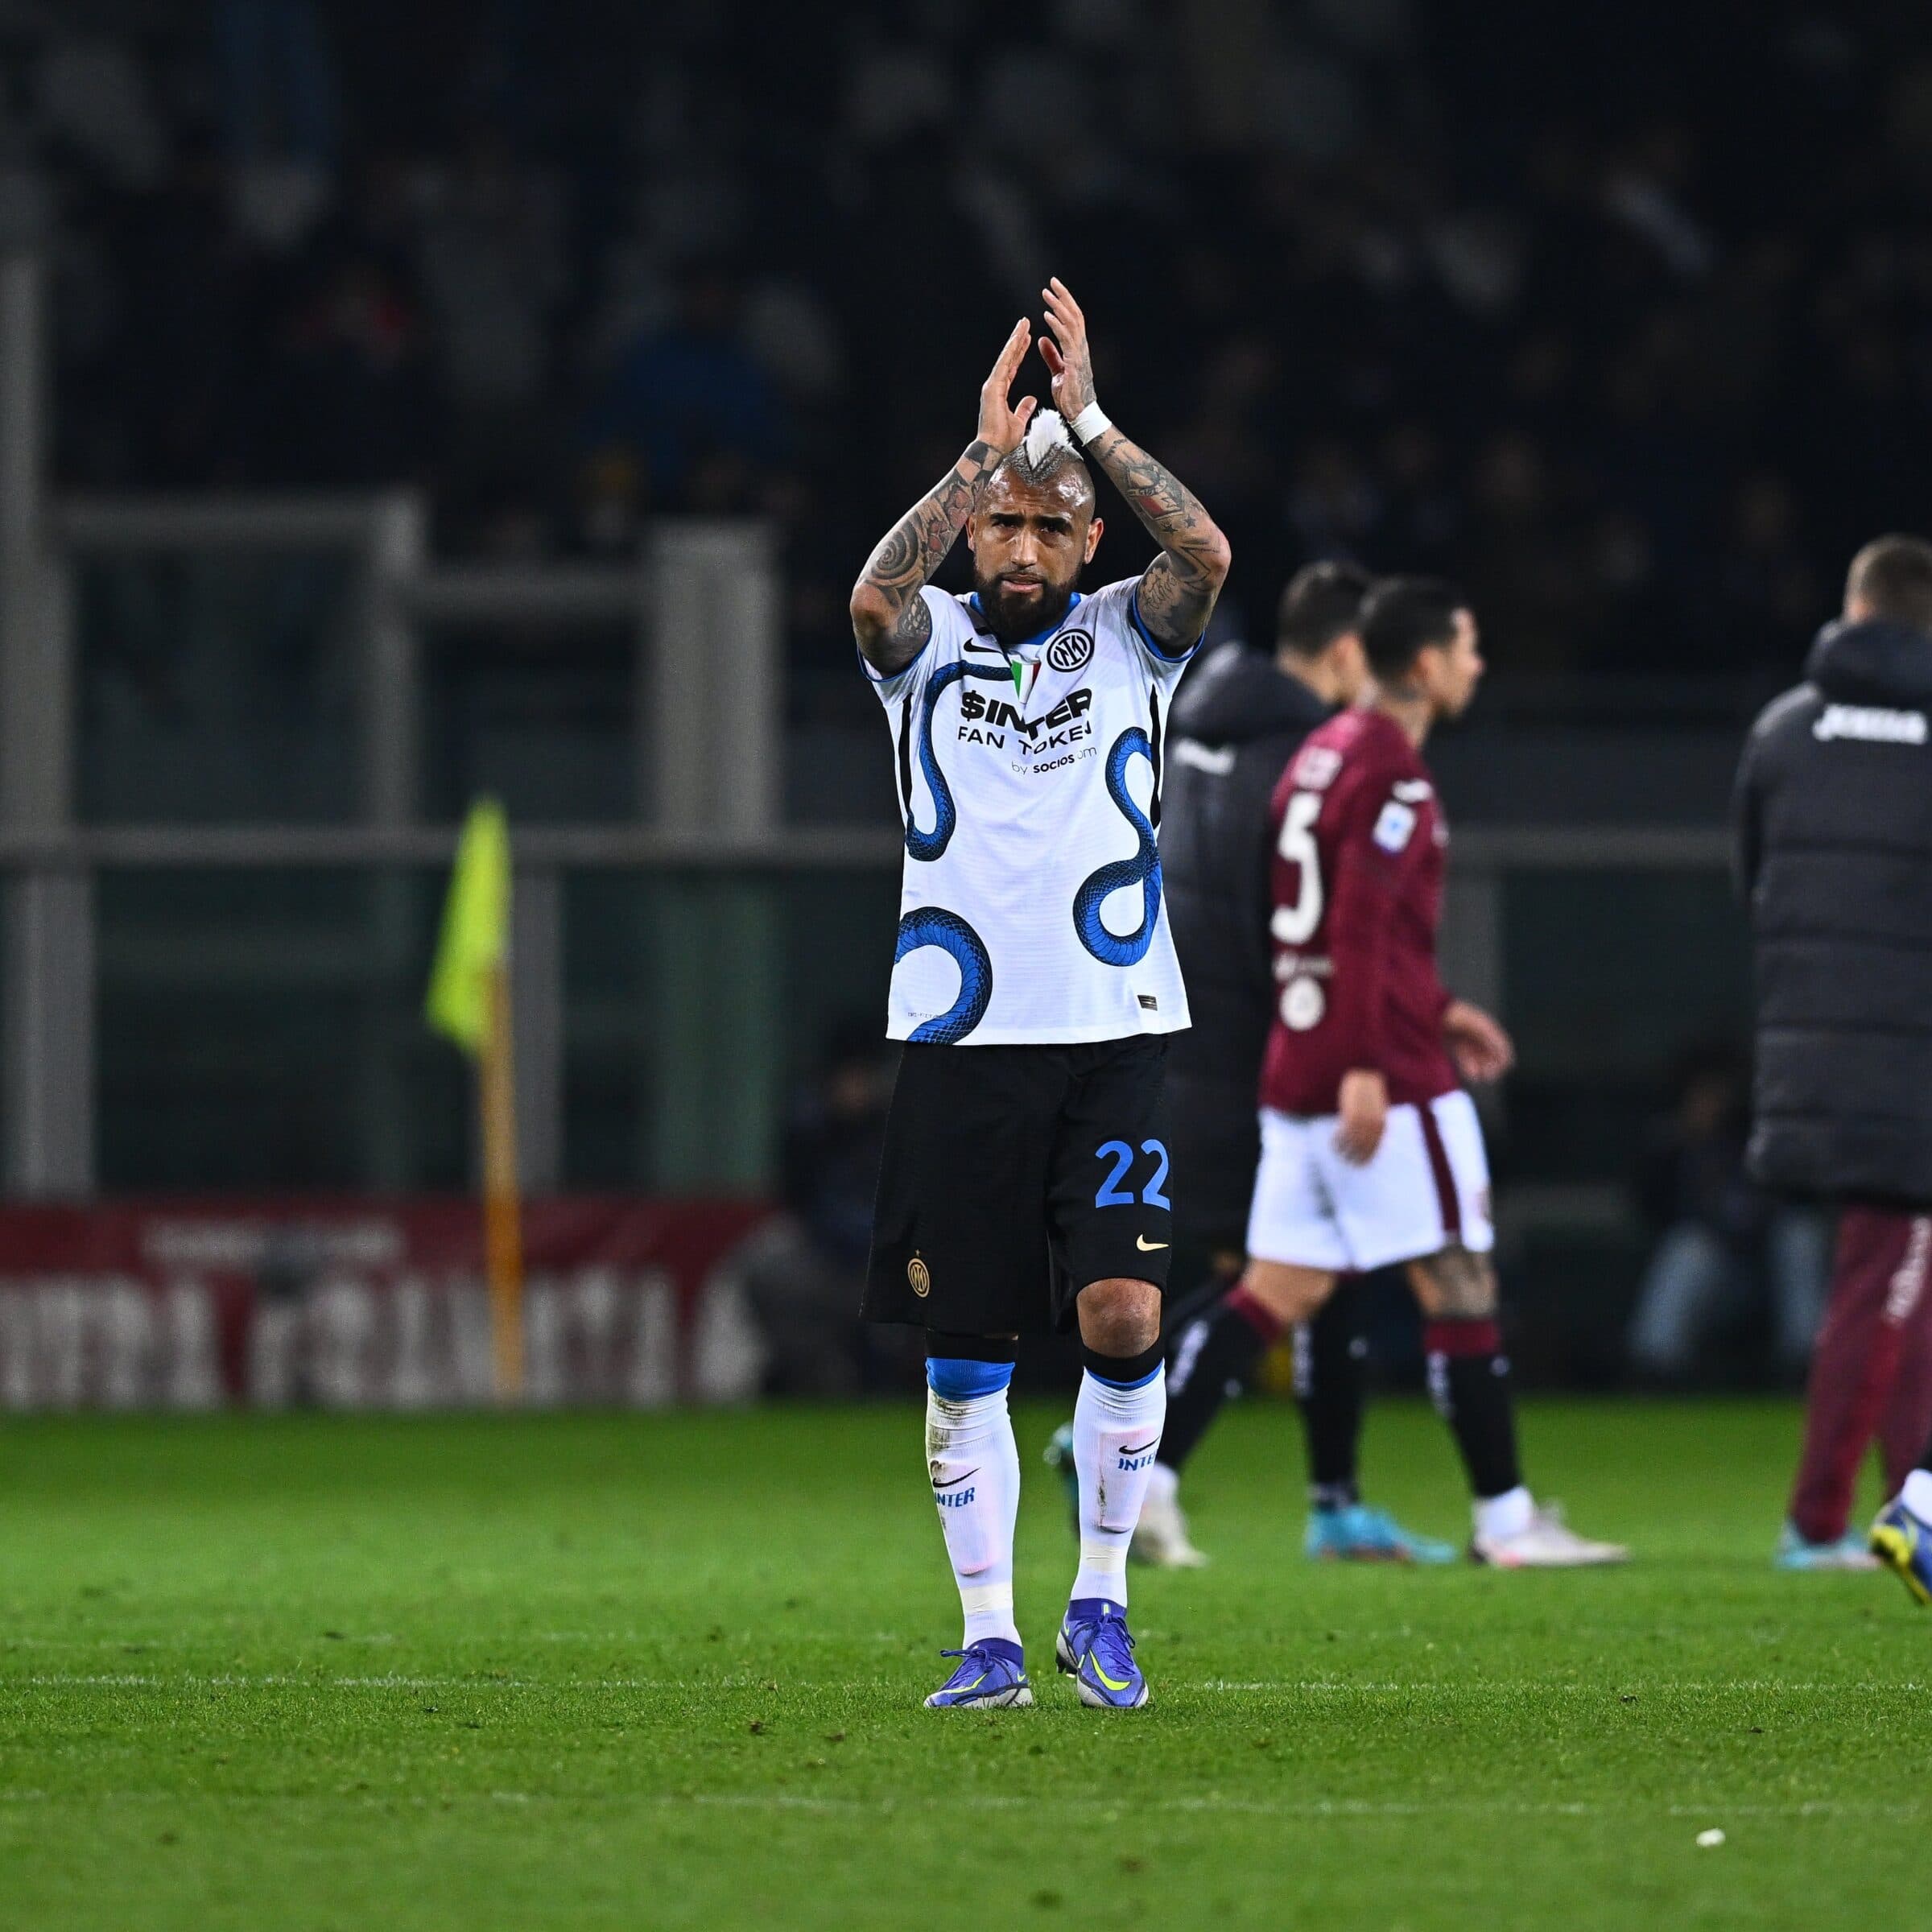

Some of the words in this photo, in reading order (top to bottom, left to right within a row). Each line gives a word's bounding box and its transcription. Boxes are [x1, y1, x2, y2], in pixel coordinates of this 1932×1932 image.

[958, 726, 1005, 749] FAN
[1011, 761, 1028, 775] by
[1269, 790, 1323, 944] 5
[1095, 1138, 1171, 1212] 22
